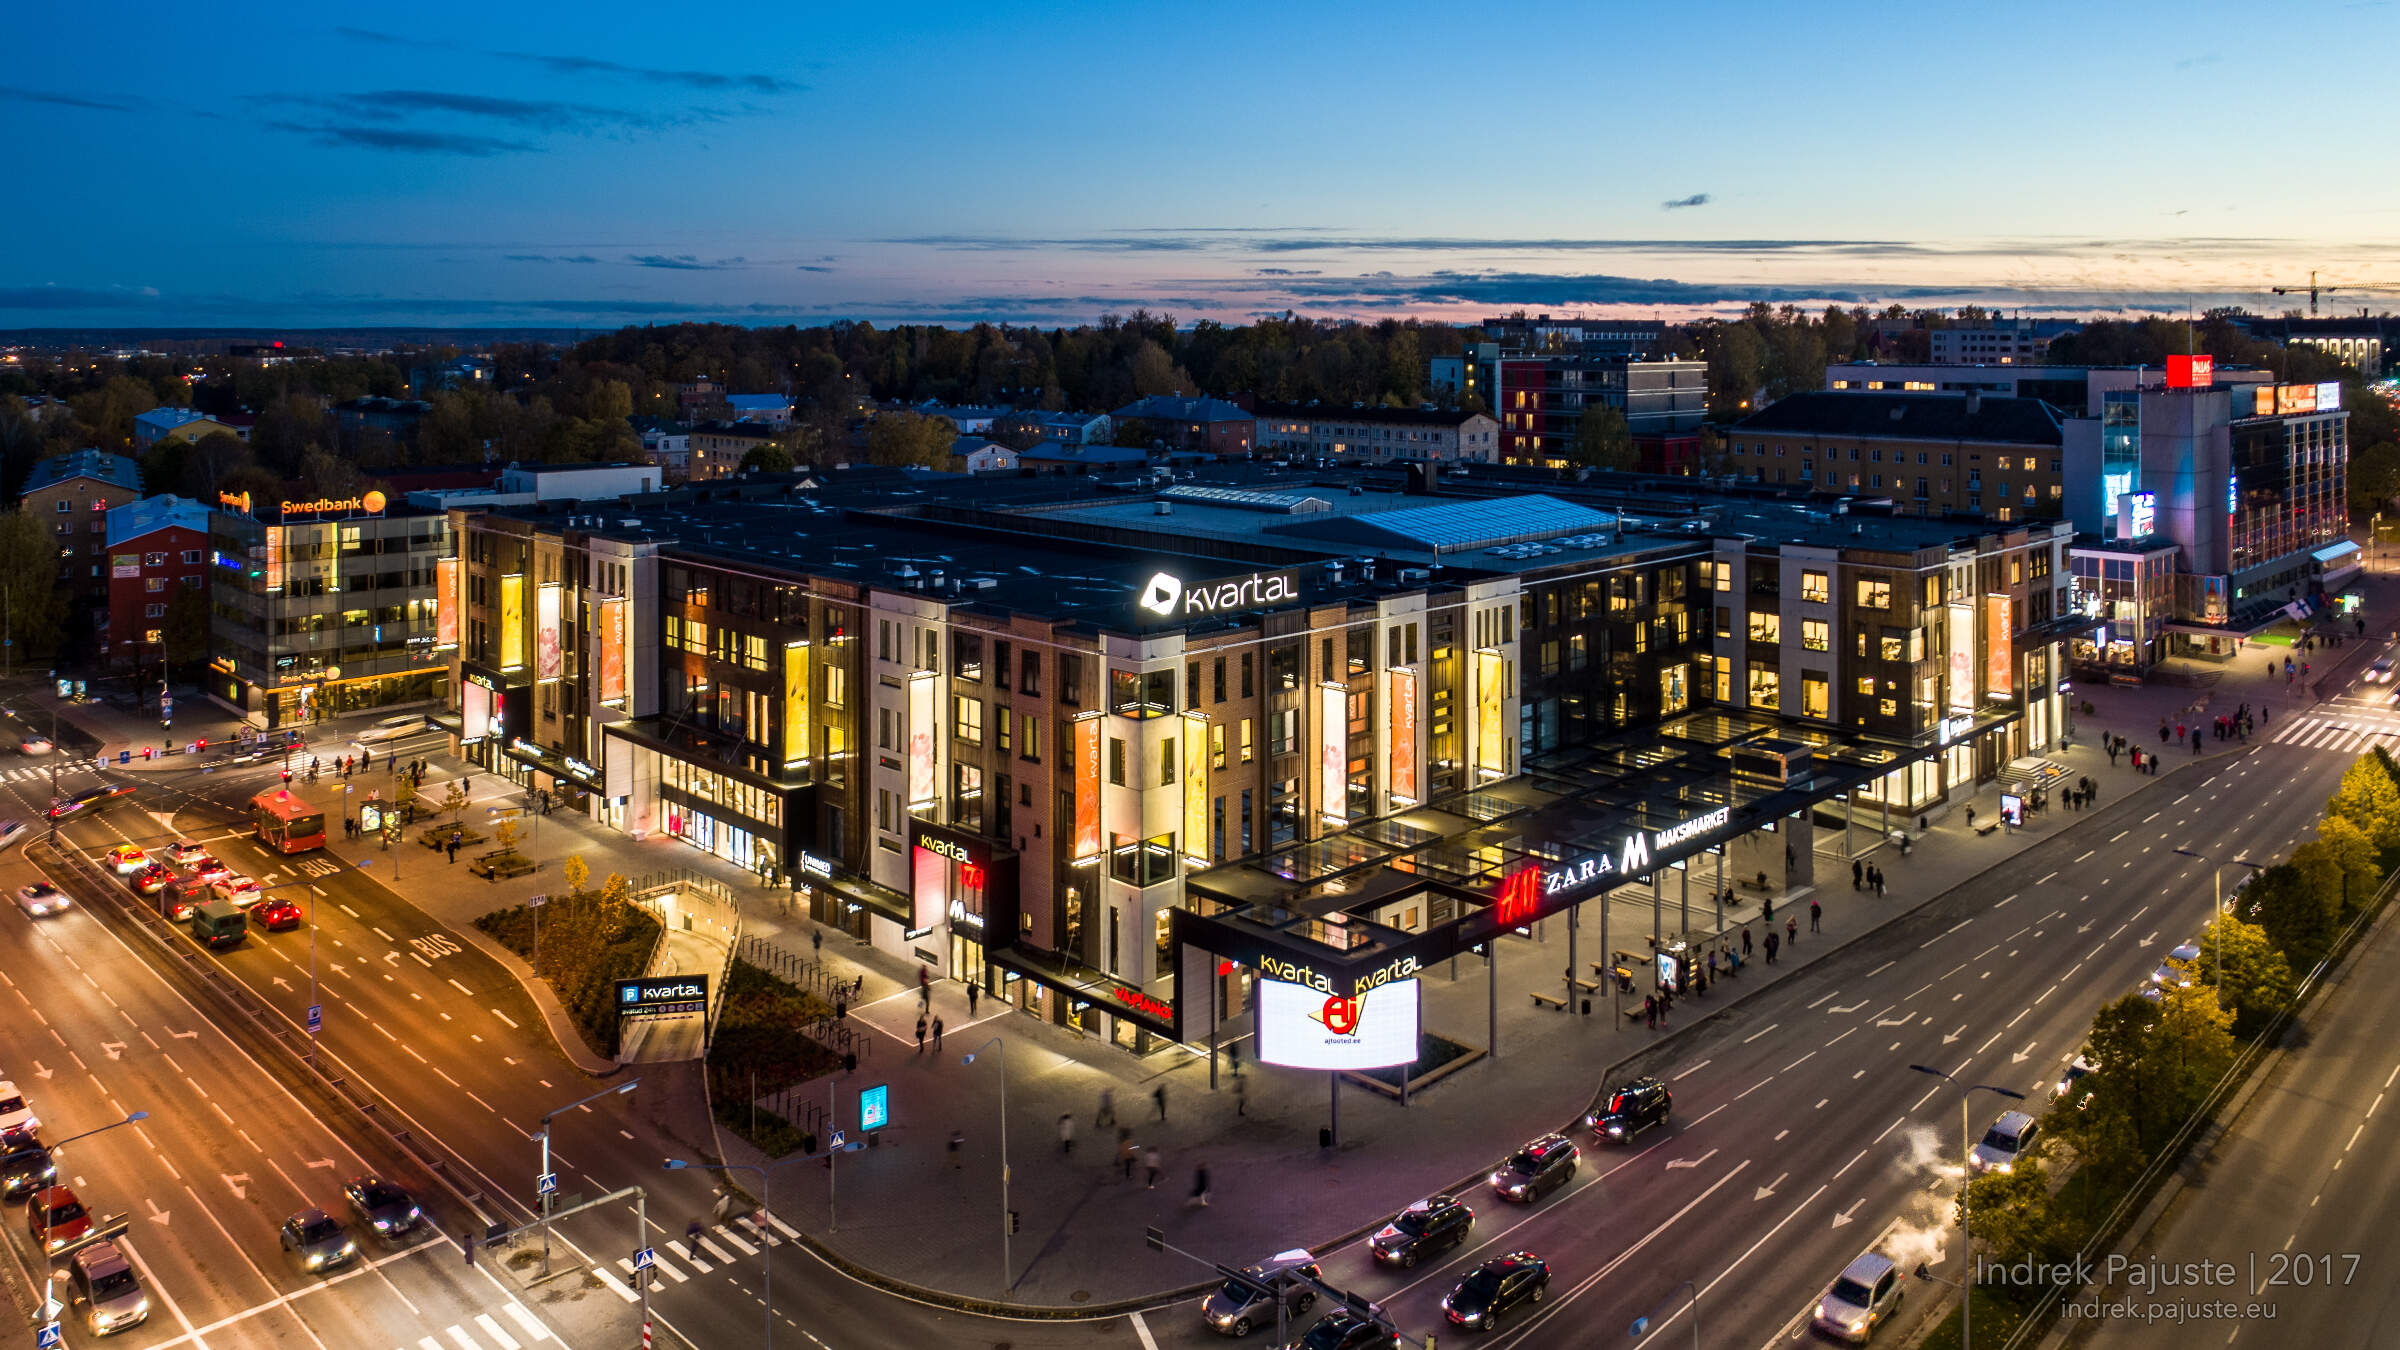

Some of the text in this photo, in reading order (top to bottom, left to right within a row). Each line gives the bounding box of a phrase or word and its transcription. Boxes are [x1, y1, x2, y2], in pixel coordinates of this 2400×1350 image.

[281, 497, 361, 514] Swedbank
[1656, 807, 1730, 849] MAKSIMARKET
[296, 858, 341, 878] BUS
[1546, 854, 1613, 895] ZARA
[408, 933, 463, 959] BUS
[1114, 987, 1172, 1019] VAPIANO
